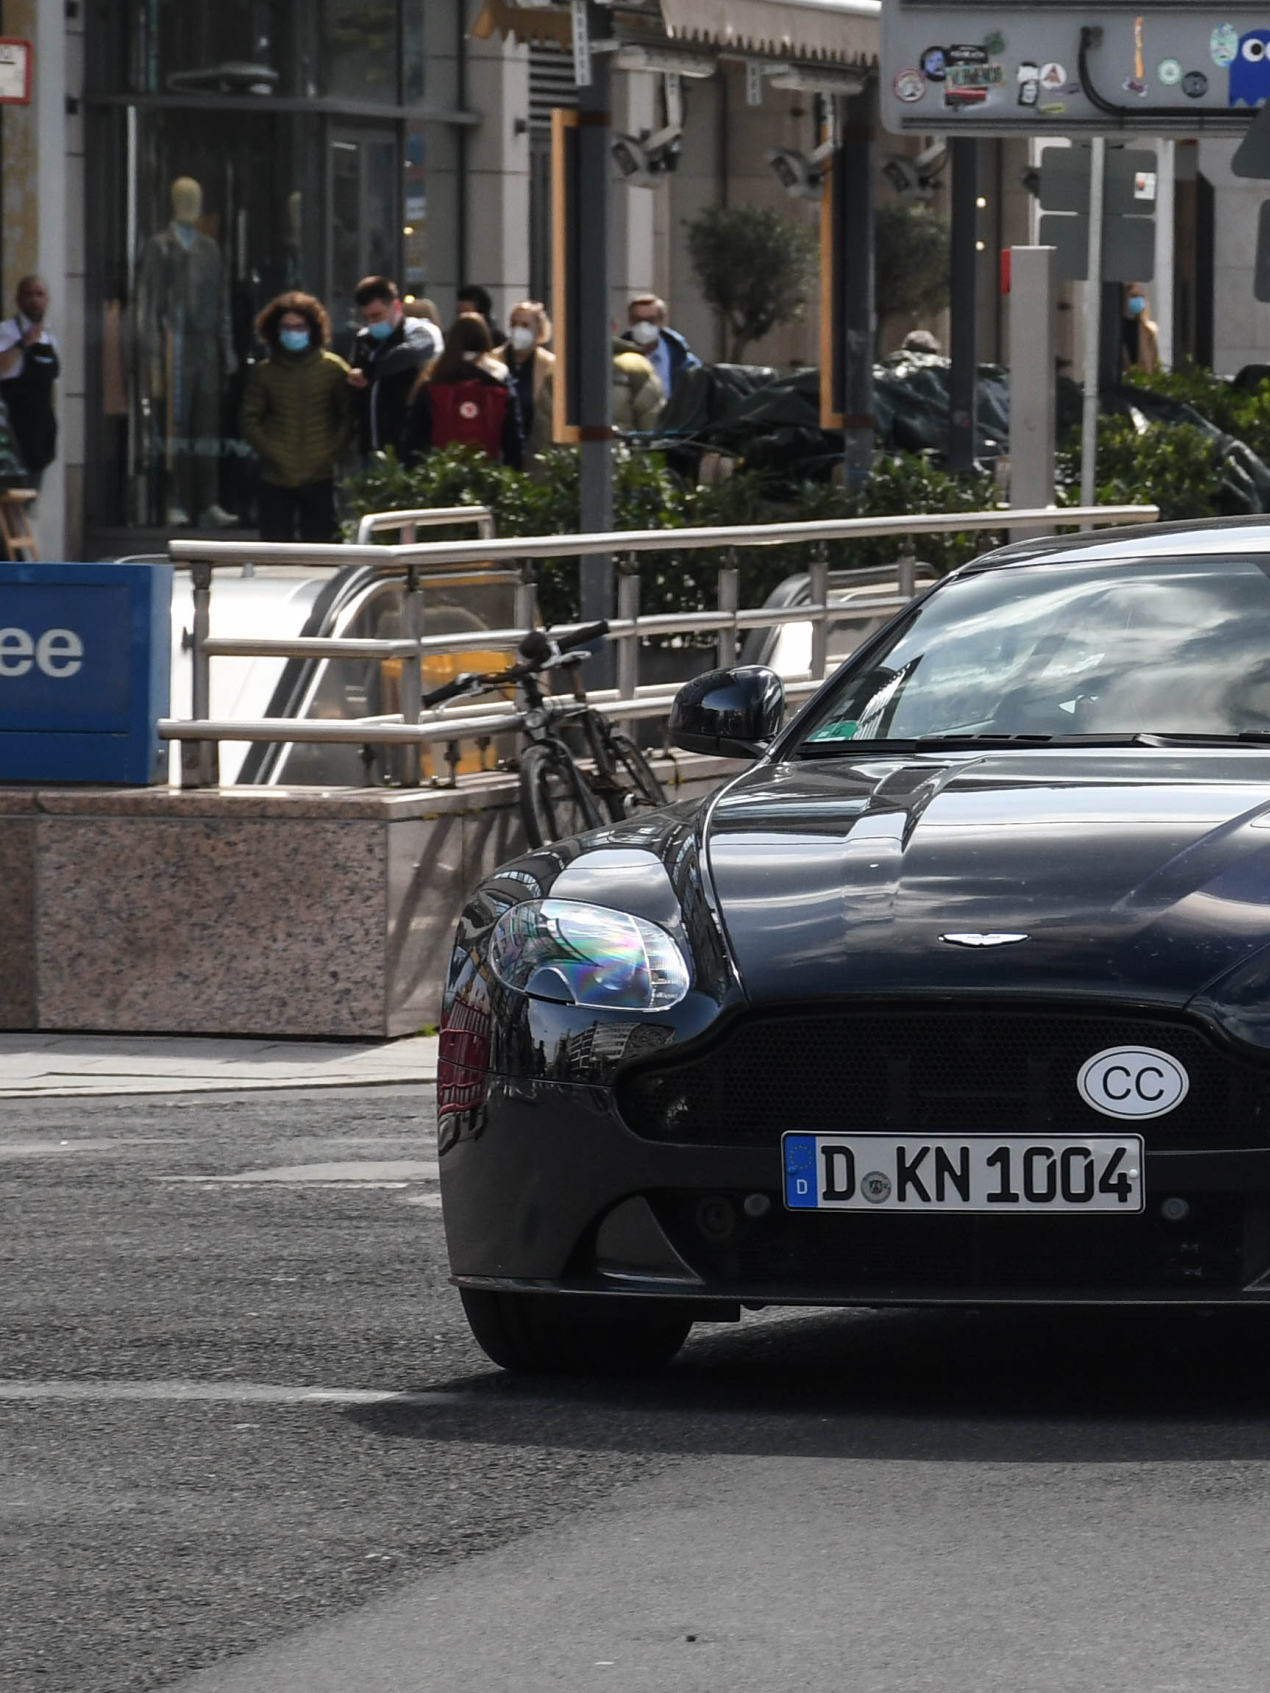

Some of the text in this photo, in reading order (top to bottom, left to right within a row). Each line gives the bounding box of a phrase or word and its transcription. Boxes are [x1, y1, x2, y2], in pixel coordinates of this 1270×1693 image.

[0, 626, 84, 678] ee
[1102, 1065, 1165, 1102] CC
[796, 1178, 808, 1195] D
[821, 1145, 1133, 1203] D KN 1004
